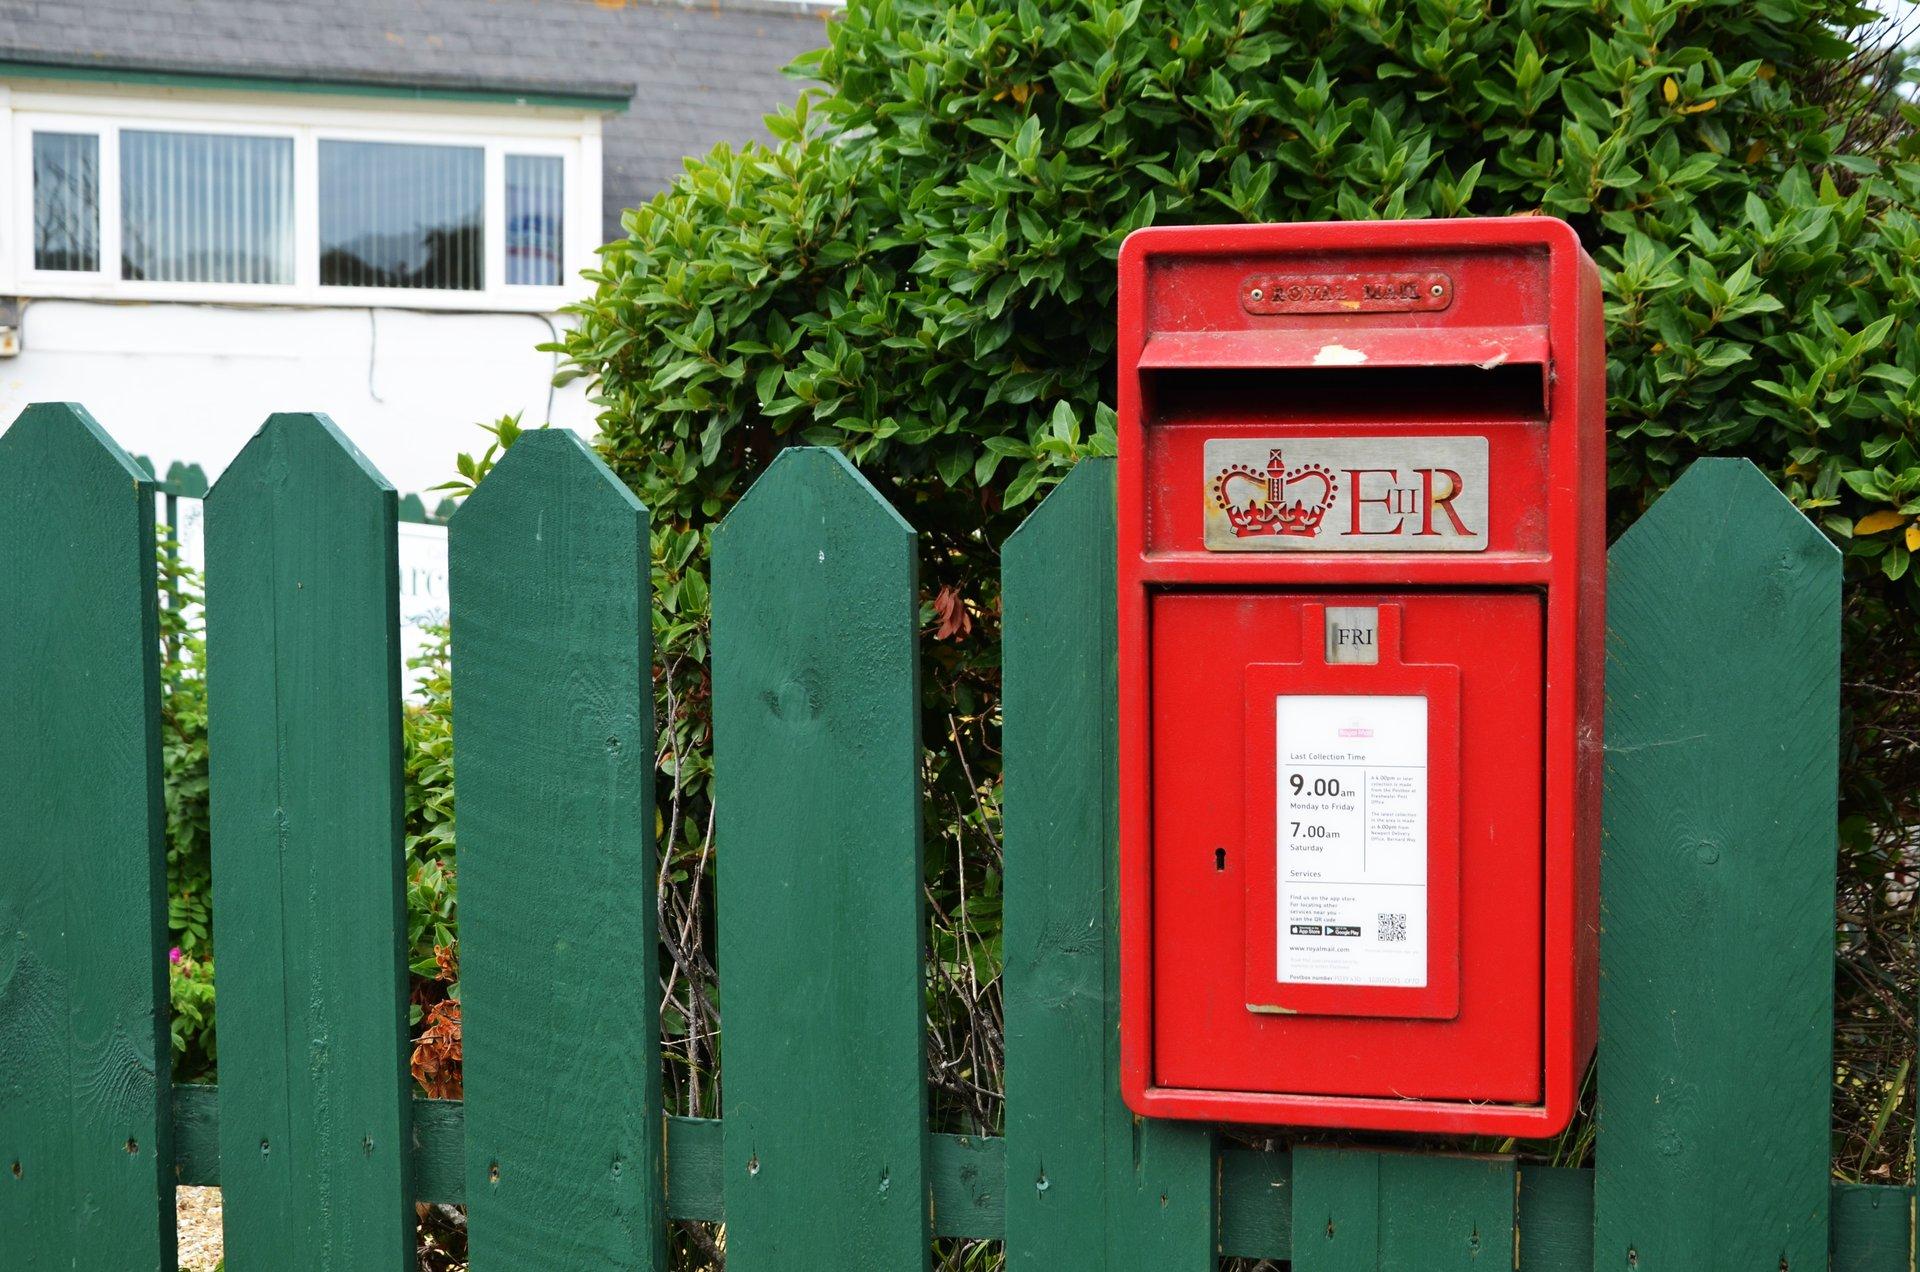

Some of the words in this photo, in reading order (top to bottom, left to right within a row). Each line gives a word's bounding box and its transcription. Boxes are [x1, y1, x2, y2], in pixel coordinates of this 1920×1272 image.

[1272, 284, 1348, 302] ROYAL
[1362, 283, 1420, 300] MAIL
[1338, 628, 1372, 645] FRI
[1290, 752, 1307, 760] Last
[1290, 773, 1355, 797] 9.00am
[1290, 802, 1319, 811] Monday
[1331, 803, 1354, 812] Friday
[1290, 822, 1340, 838] 7.00am
[1290, 843, 1323, 852] Saturday
